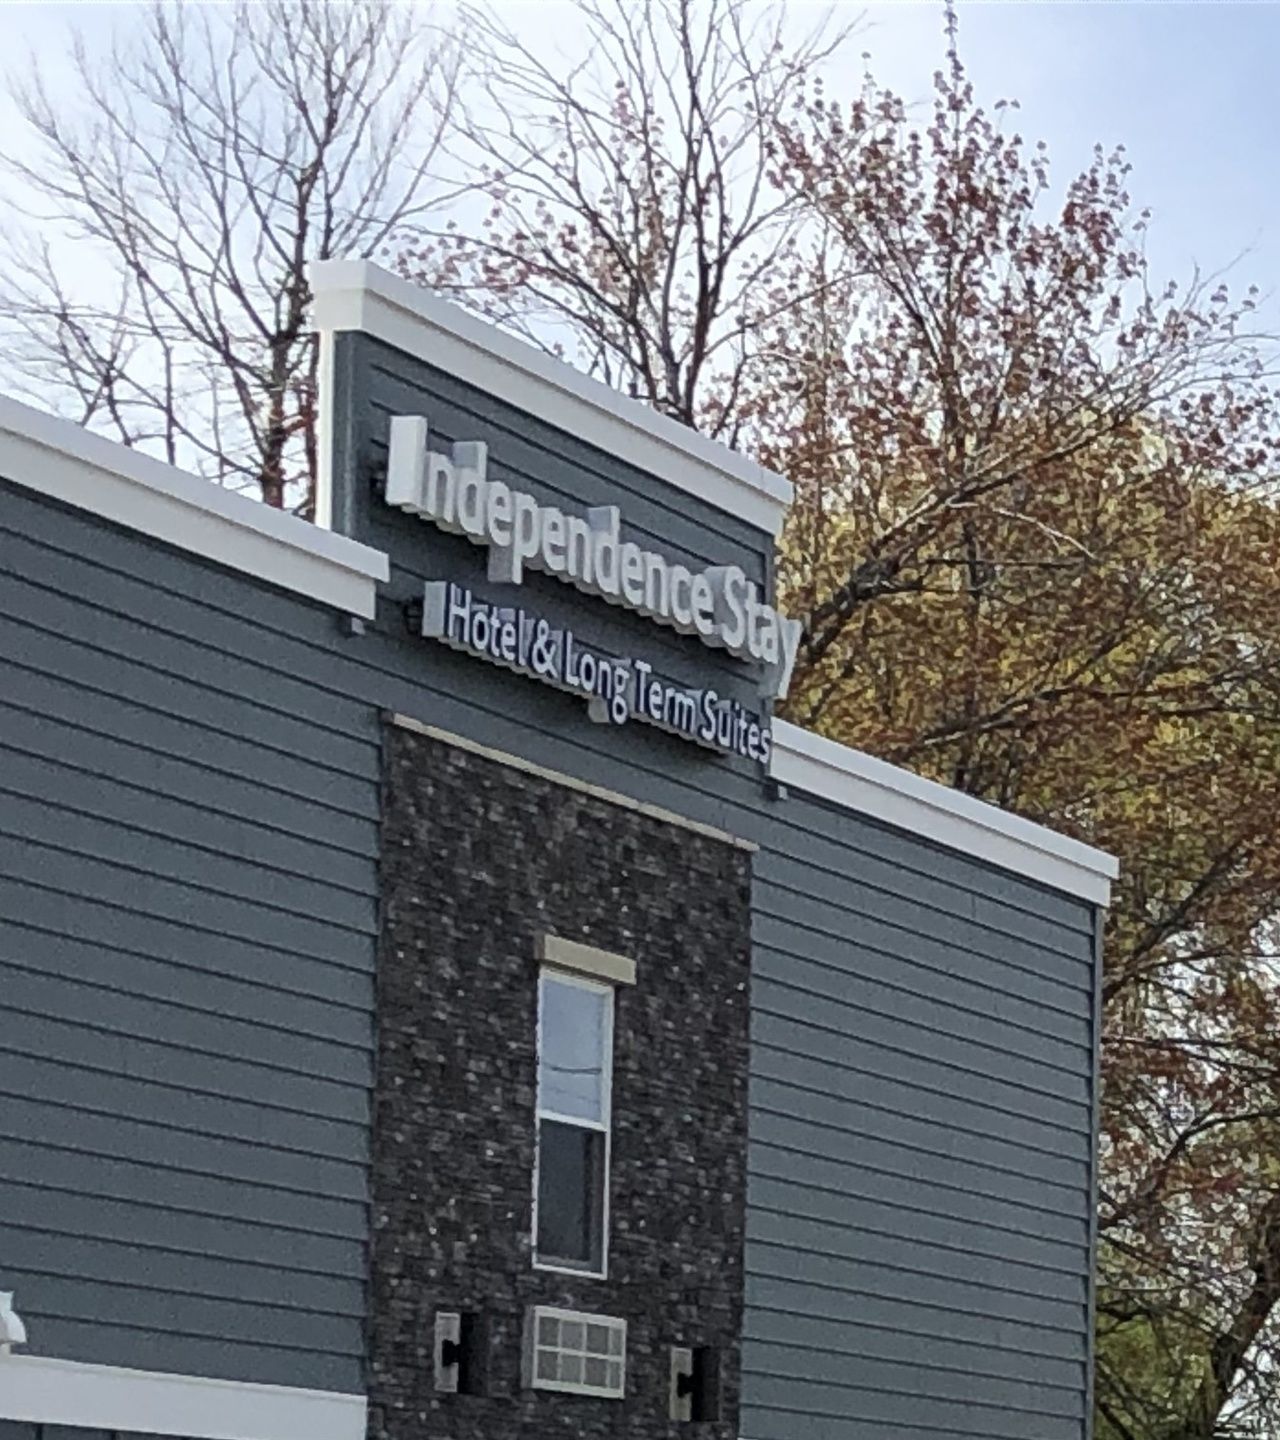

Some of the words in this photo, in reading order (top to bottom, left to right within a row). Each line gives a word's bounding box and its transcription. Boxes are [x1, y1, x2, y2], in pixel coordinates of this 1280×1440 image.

[386, 415, 716, 638] Independence
[716, 564, 802, 699] Stay
[444, 582, 526, 667] Hotel
[530, 619, 558, 676] &
[565, 631, 631, 725] Long
[634, 659, 697, 735] Term
[699, 690, 773, 764] Suites
